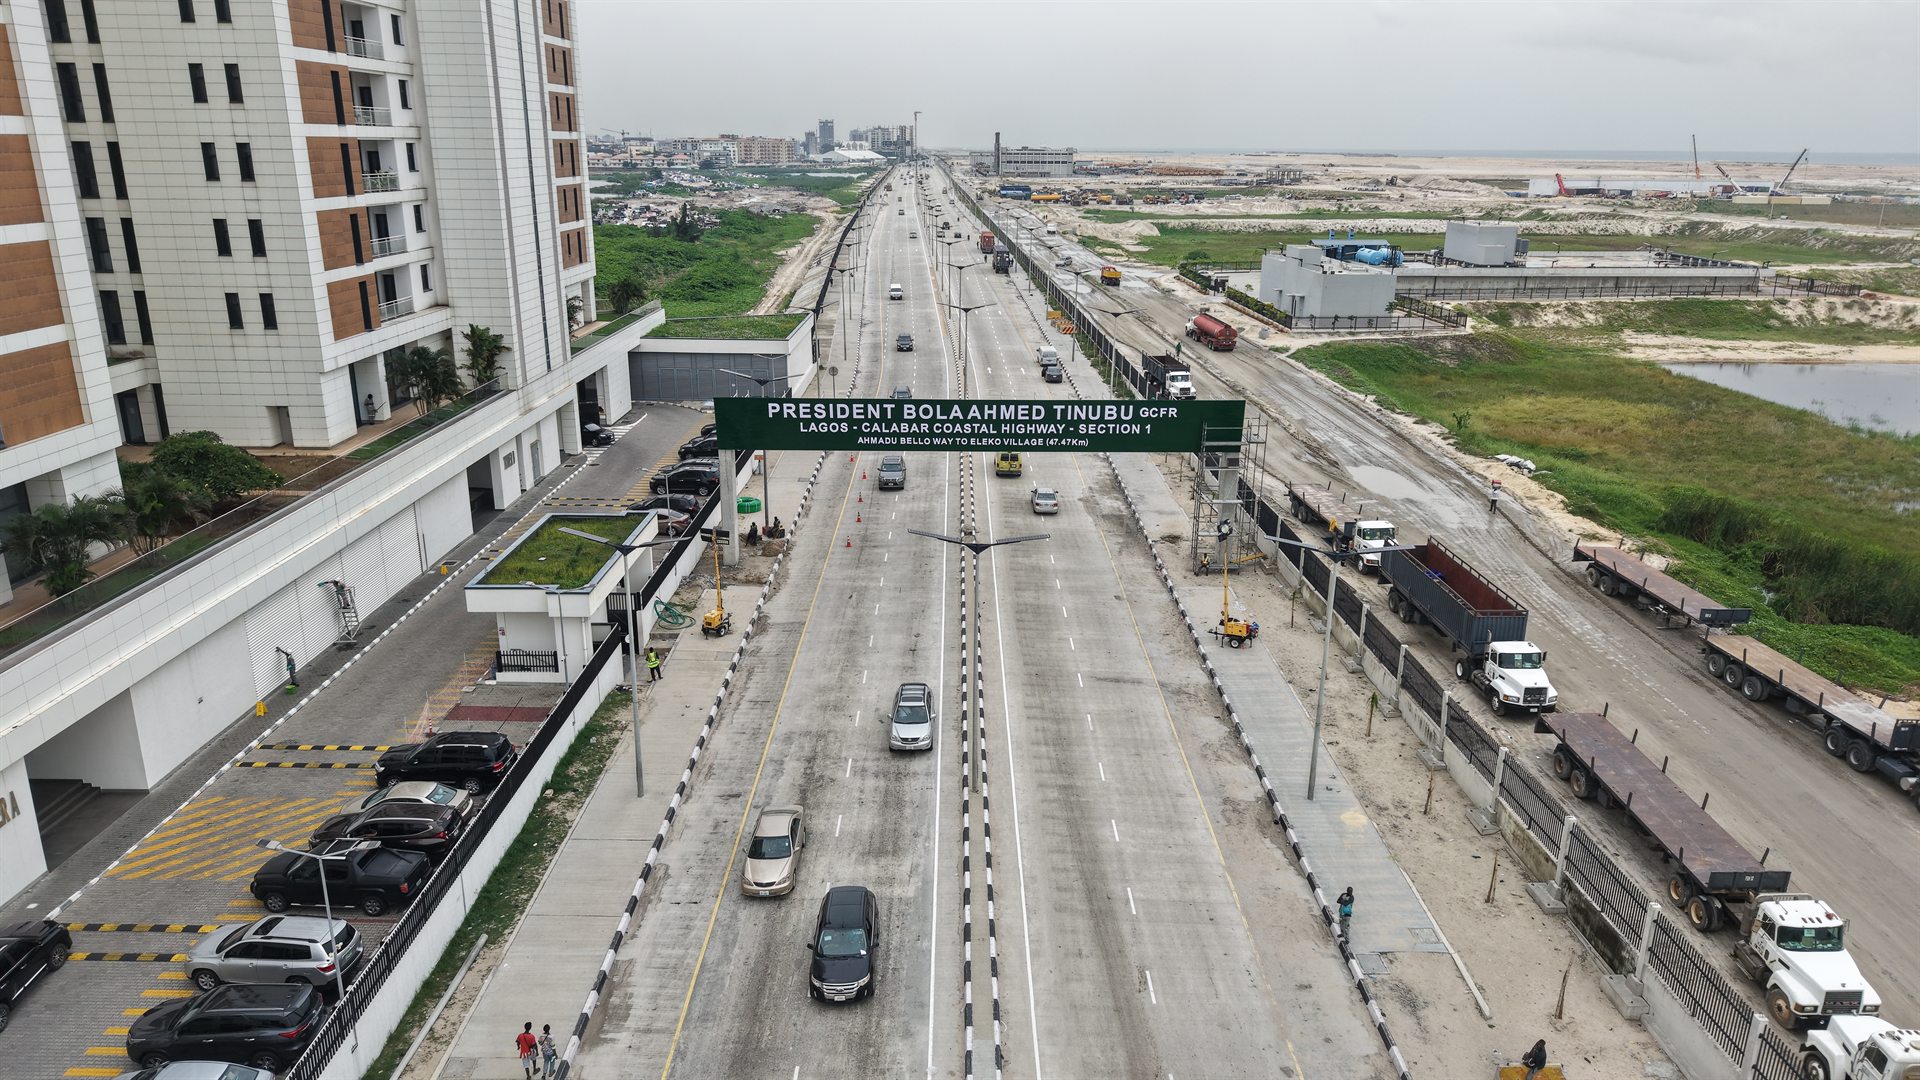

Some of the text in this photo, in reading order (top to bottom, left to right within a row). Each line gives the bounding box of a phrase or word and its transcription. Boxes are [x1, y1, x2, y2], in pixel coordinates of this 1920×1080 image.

[767, 402, 896, 419] PRESIDENT
[1052, 404, 1134, 421] TINUBU
[1139, 406, 1178, 418] GCFR
[799, 421, 849, 433] LAGOS
[861, 422, 930, 434] CALABAR
[933, 422, 998, 434] COASTAL
[1001, 423, 1066, 434] HIGHWAY
[1078, 423, 1141, 435] SECTION
[1144, 423, 1151, 435] 1
[857, 436, 1089, 447] AHMADU BELLO WAY TO ELEKO VILLAGE (47.47Km)
